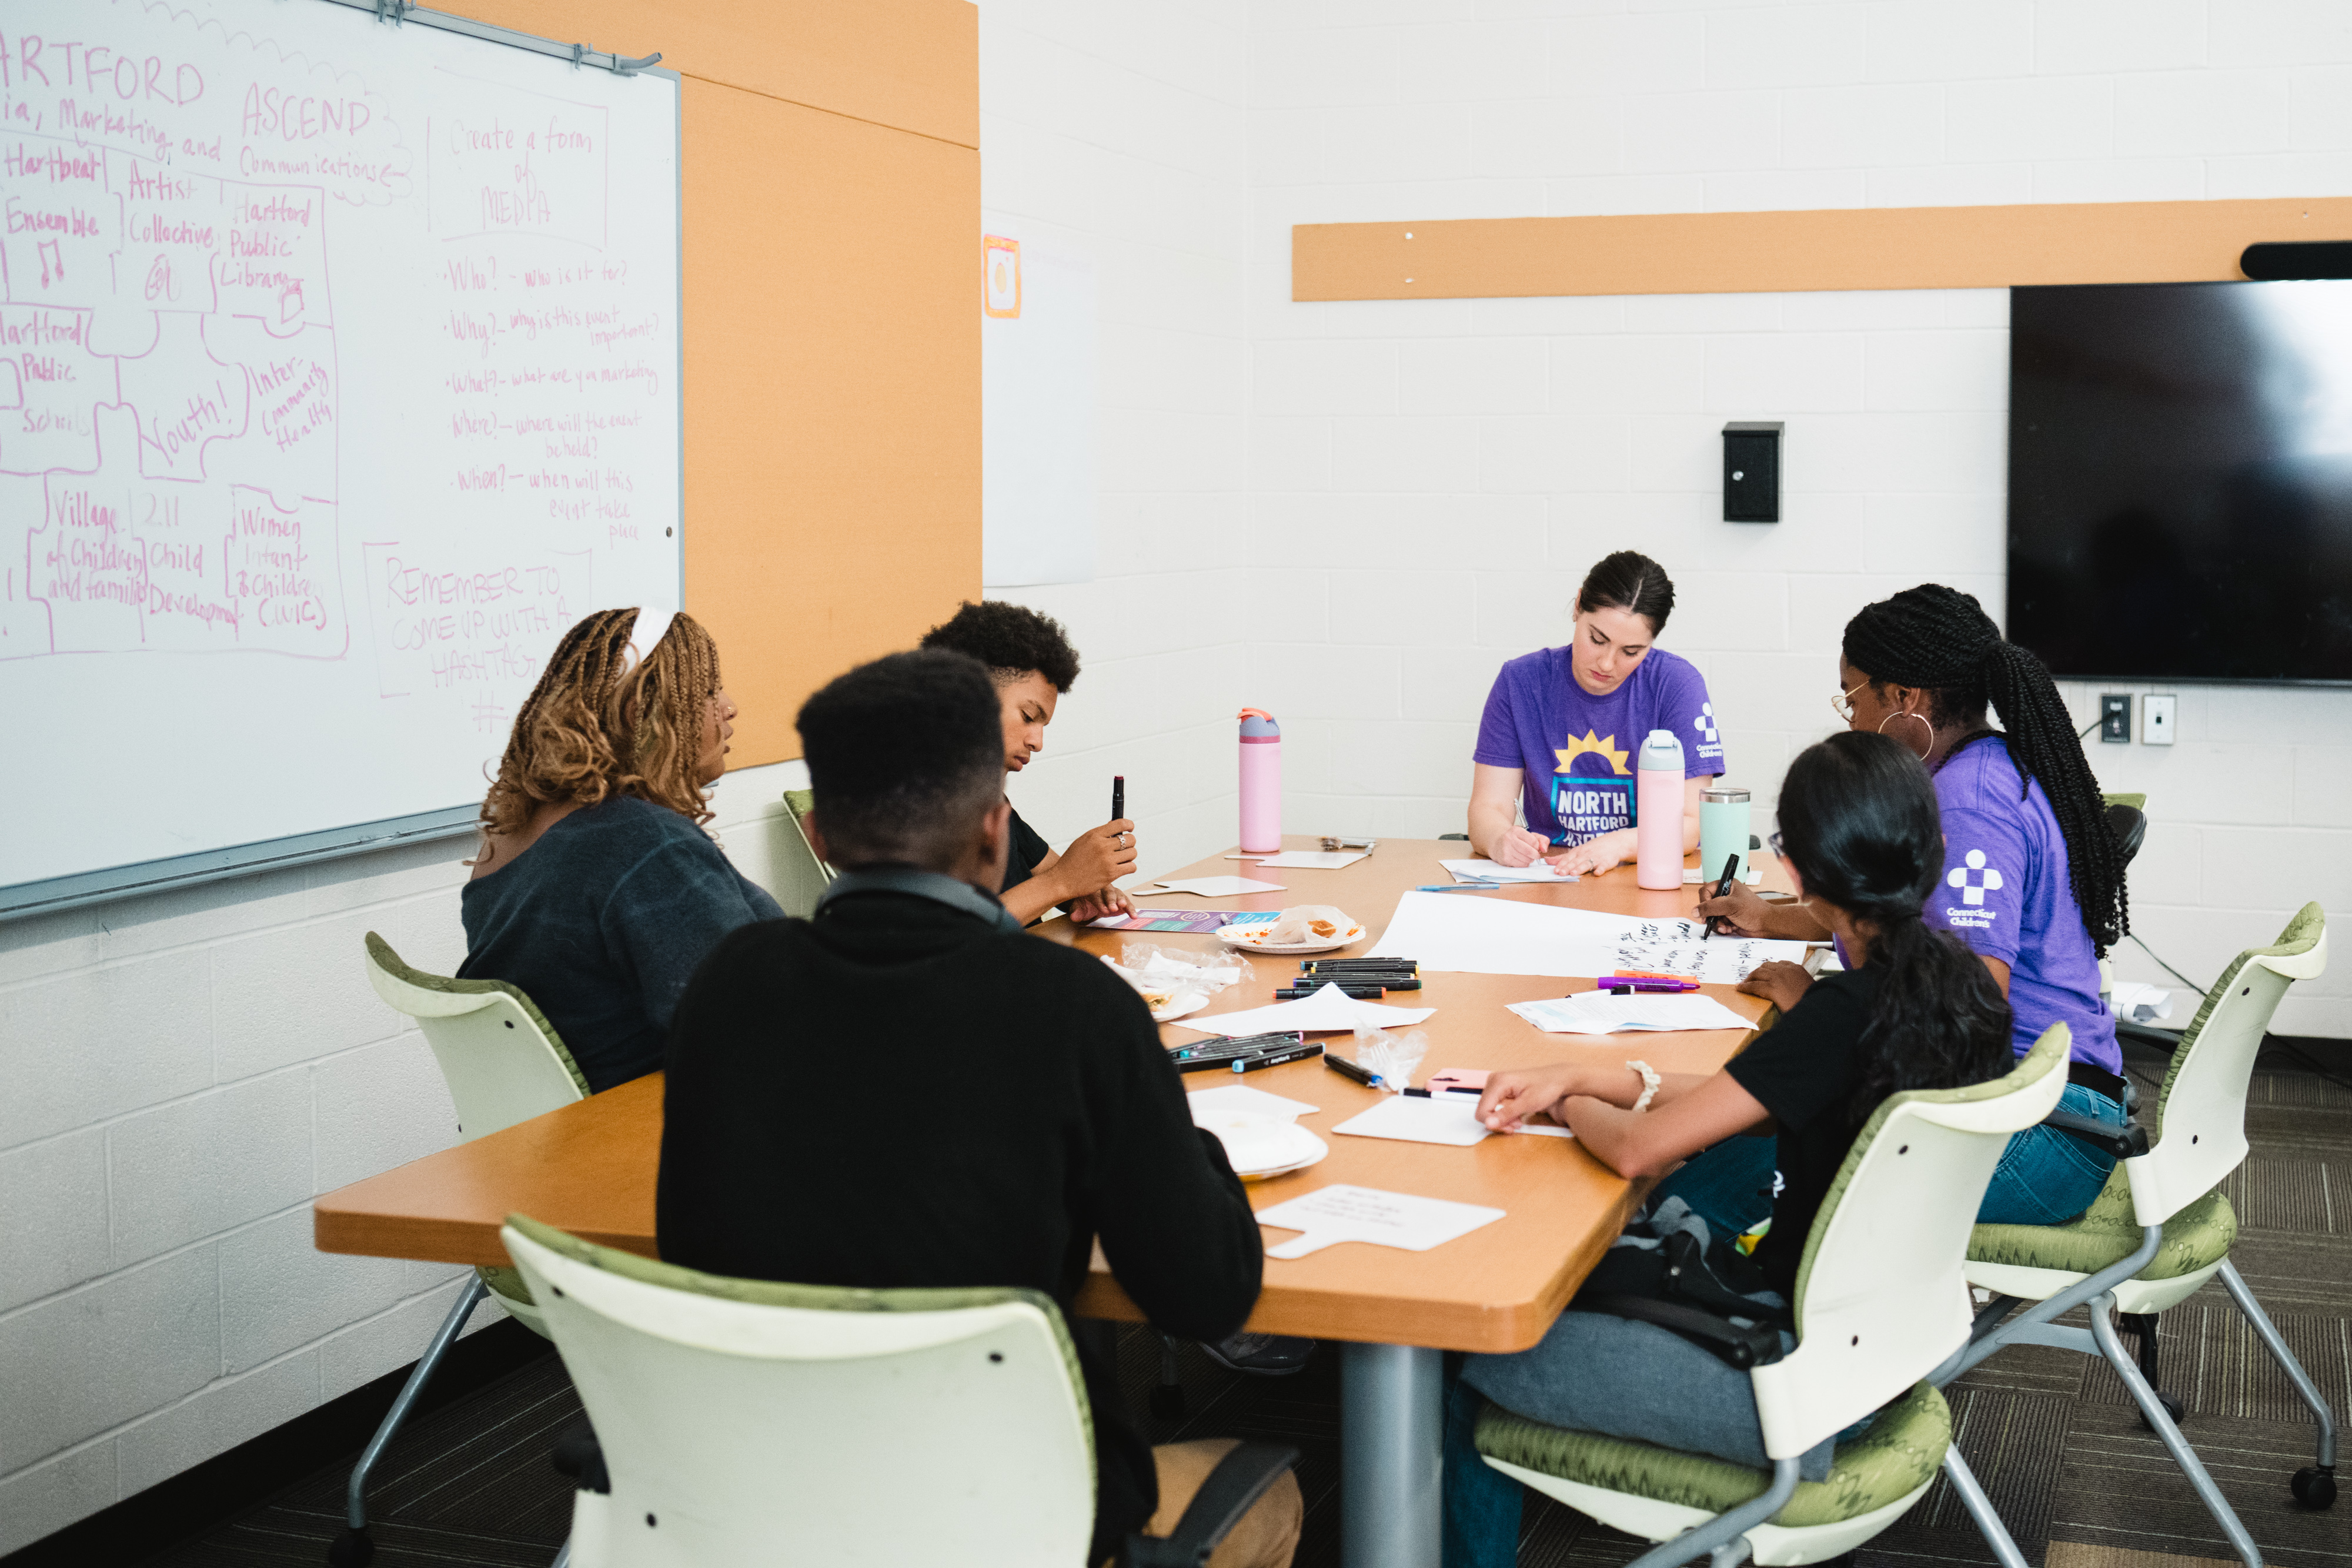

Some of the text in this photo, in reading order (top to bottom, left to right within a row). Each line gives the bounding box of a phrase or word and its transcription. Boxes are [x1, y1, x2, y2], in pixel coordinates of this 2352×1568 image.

[59, 99, 173, 161] Marketing
[182, 135, 221, 162] and
[242, 82, 370, 142] ASCEND
[451, 115, 592, 155] Create a form
[129, 159, 198, 200] Artist
[240, 145, 376, 182] Communications
[514, 150, 537, 203] of
[6, 196, 213, 248] Ensemble Collective
[235, 193, 311, 227] Hartford
[231, 229, 292, 258] Public
[447, 255, 497, 292] Who?
[525, 268, 551, 287] who
[558, 266, 572, 285] is
[602, 259, 627, 286] for?
[452, 312, 496, 360] Why?
[510, 307, 536, 341] why
[537, 309, 552, 330] is
[552, 305, 582, 327] this
[22, 353, 76, 382] Public
[452, 369, 498, 397] What?
[512, 366, 546, 387] what
[549, 368, 572, 383] are
[575, 370, 597, 393] you
[601, 359, 659, 396] marketing
[141, 379, 232, 468] Youth!
[452, 409, 498, 440] Where?
[516, 413, 555, 436] where
[557, 412, 581, 432] will
[584, 410, 607, 432] the
[609, 409, 643, 427] event
[544, 435, 598, 460] be held?
[457, 463, 506, 493] When?
[529, 468, 570, 490] when
[574, 468, 599, 492] will
[604, 467, 633, 493] this
[549, 494, 631, 521] event take
[609, 522, 640, 550] place
[150, 541, 203, 578] Child
[48, 571, 81, 602] and
[253, 573, 318, 599] Childre
[386, 556, 560, 609] REMEMBER TO
[391, 594, 572, 651] COME UP WITH A
[430, 641, 537, 689] HASHTAG
[470, 688, 509, 734] #
[1558, 790, 1628, 815] NORTH
[1558, 815, 1629, 832] HARTFORD
[1946, 907, 1997, 920] Connecticut
[1950, 917, 1991, 929] Children's
